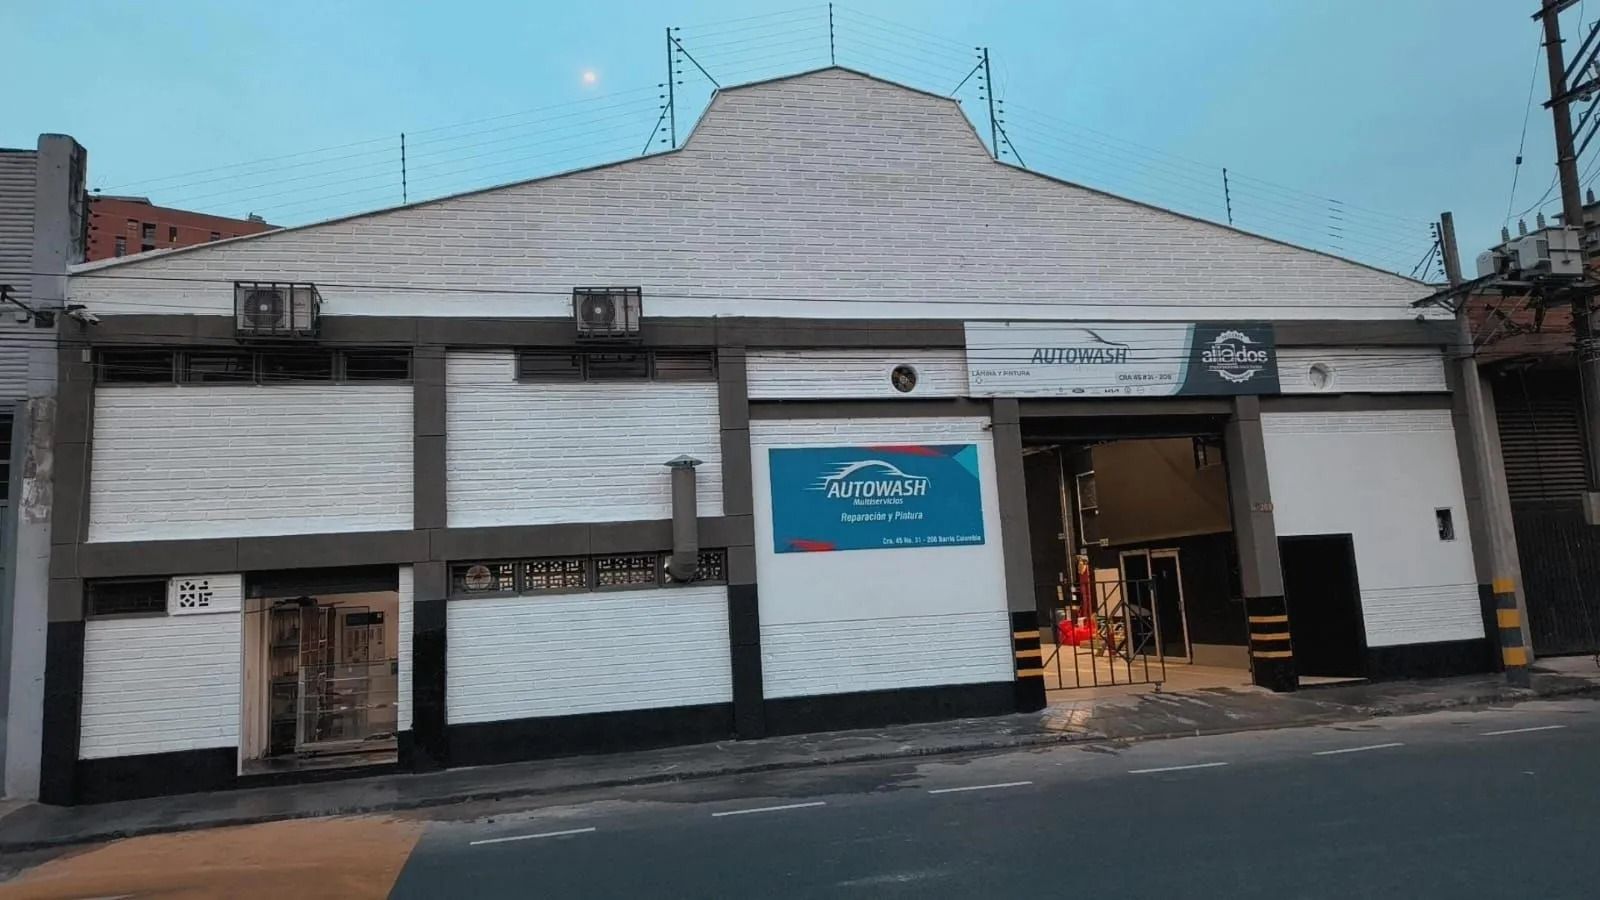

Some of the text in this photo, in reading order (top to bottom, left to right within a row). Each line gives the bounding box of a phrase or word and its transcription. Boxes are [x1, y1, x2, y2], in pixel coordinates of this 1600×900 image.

[1031, 347, 1127, 364] AUTOWASH
[827, 479, 927, 498] AUTOWASH
[853, 497, 904, 506] Multiservicios
[841, 510, 924, 523] Reparación y Pintura
[956, 534, 981, 542] Colombia
